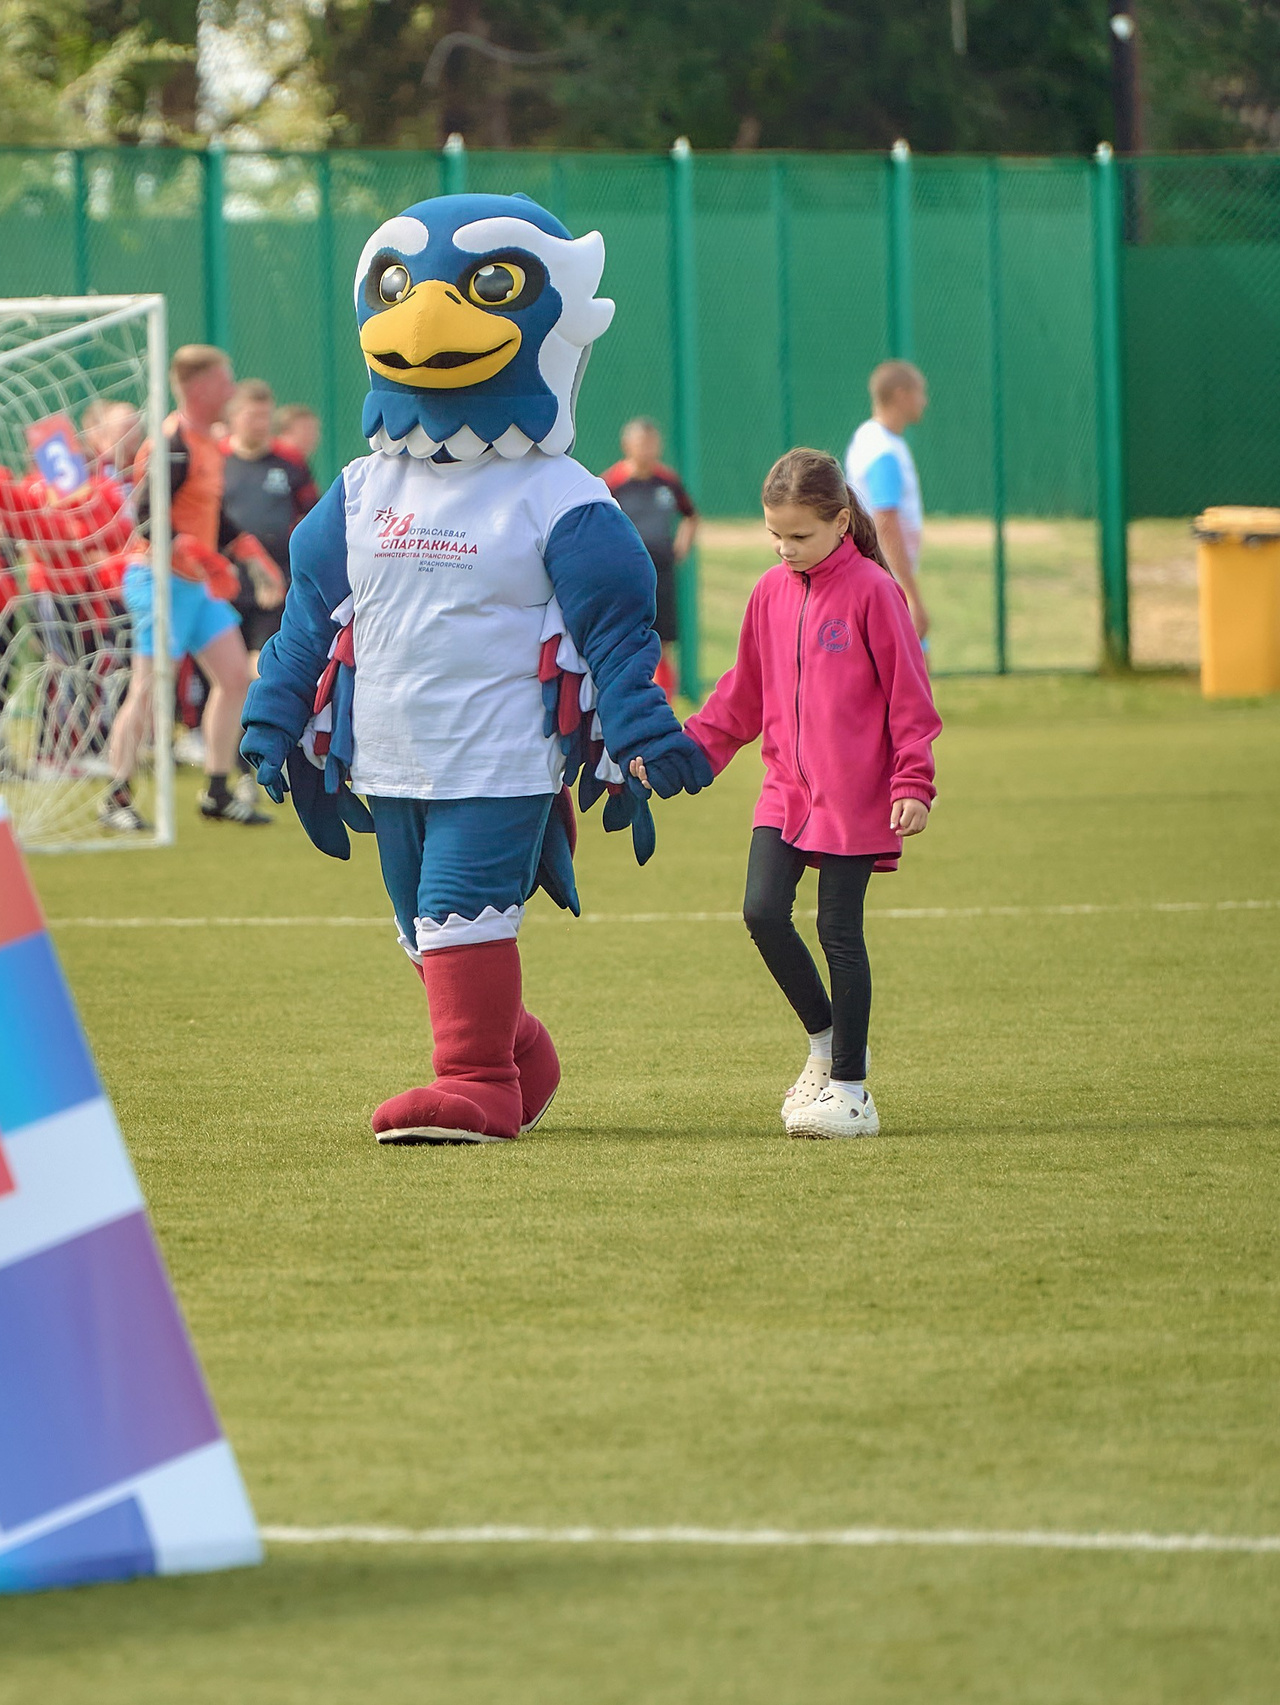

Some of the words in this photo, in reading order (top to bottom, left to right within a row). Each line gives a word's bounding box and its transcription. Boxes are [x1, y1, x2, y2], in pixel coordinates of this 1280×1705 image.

[46, 441, 78, 490] 3
[378, 513, 415, 538] 18
[410, 528, 466, 538] ОТРАСЛЕВАЯ
[381, 539, 478, 555] СПАРТАКИАДА
[421, 552, 461, 561] ТРАНСПОРТА
[419, 560, 473, 570] КРАСНОЯРСКОГО
